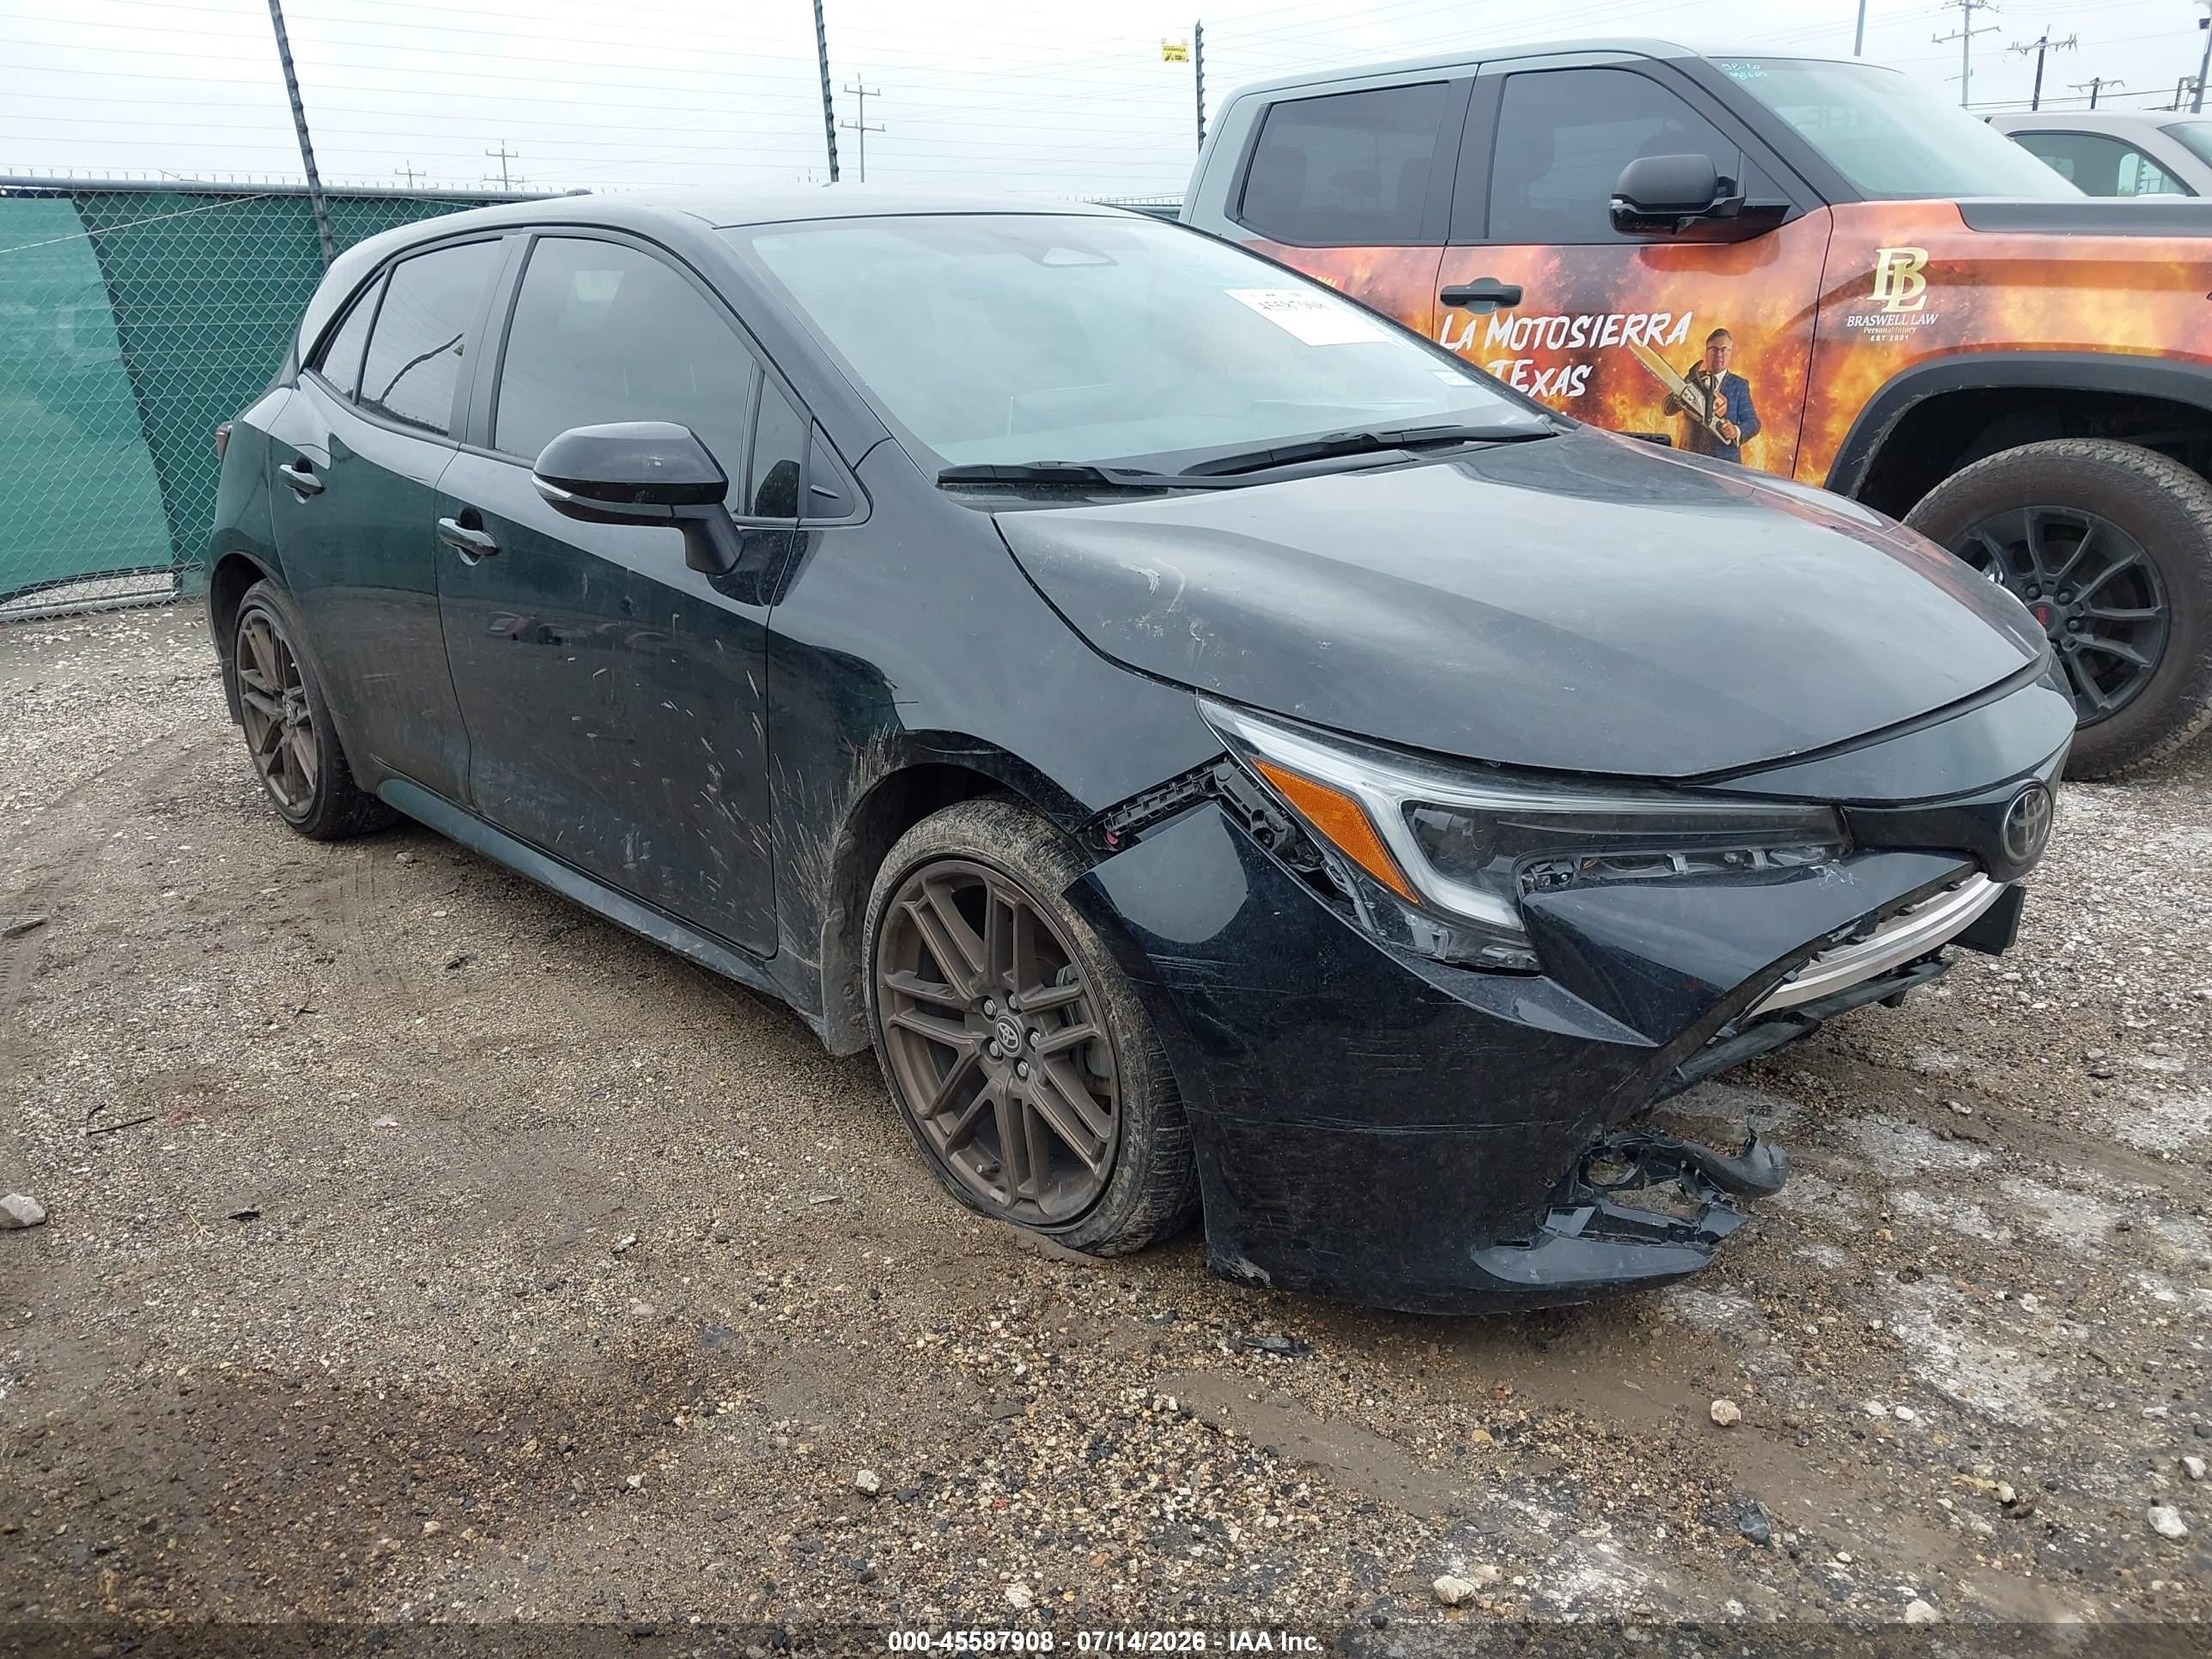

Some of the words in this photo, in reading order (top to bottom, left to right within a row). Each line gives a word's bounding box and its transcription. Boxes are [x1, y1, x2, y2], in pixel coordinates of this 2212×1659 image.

[1484, 311, 1693, 352] MOTOSIERRA
[1847, 314, 1909, 326] BRASWELL
[1910, 314, 1939, 325] LAW
[1486, 358, 1593, 398] TEXAS
